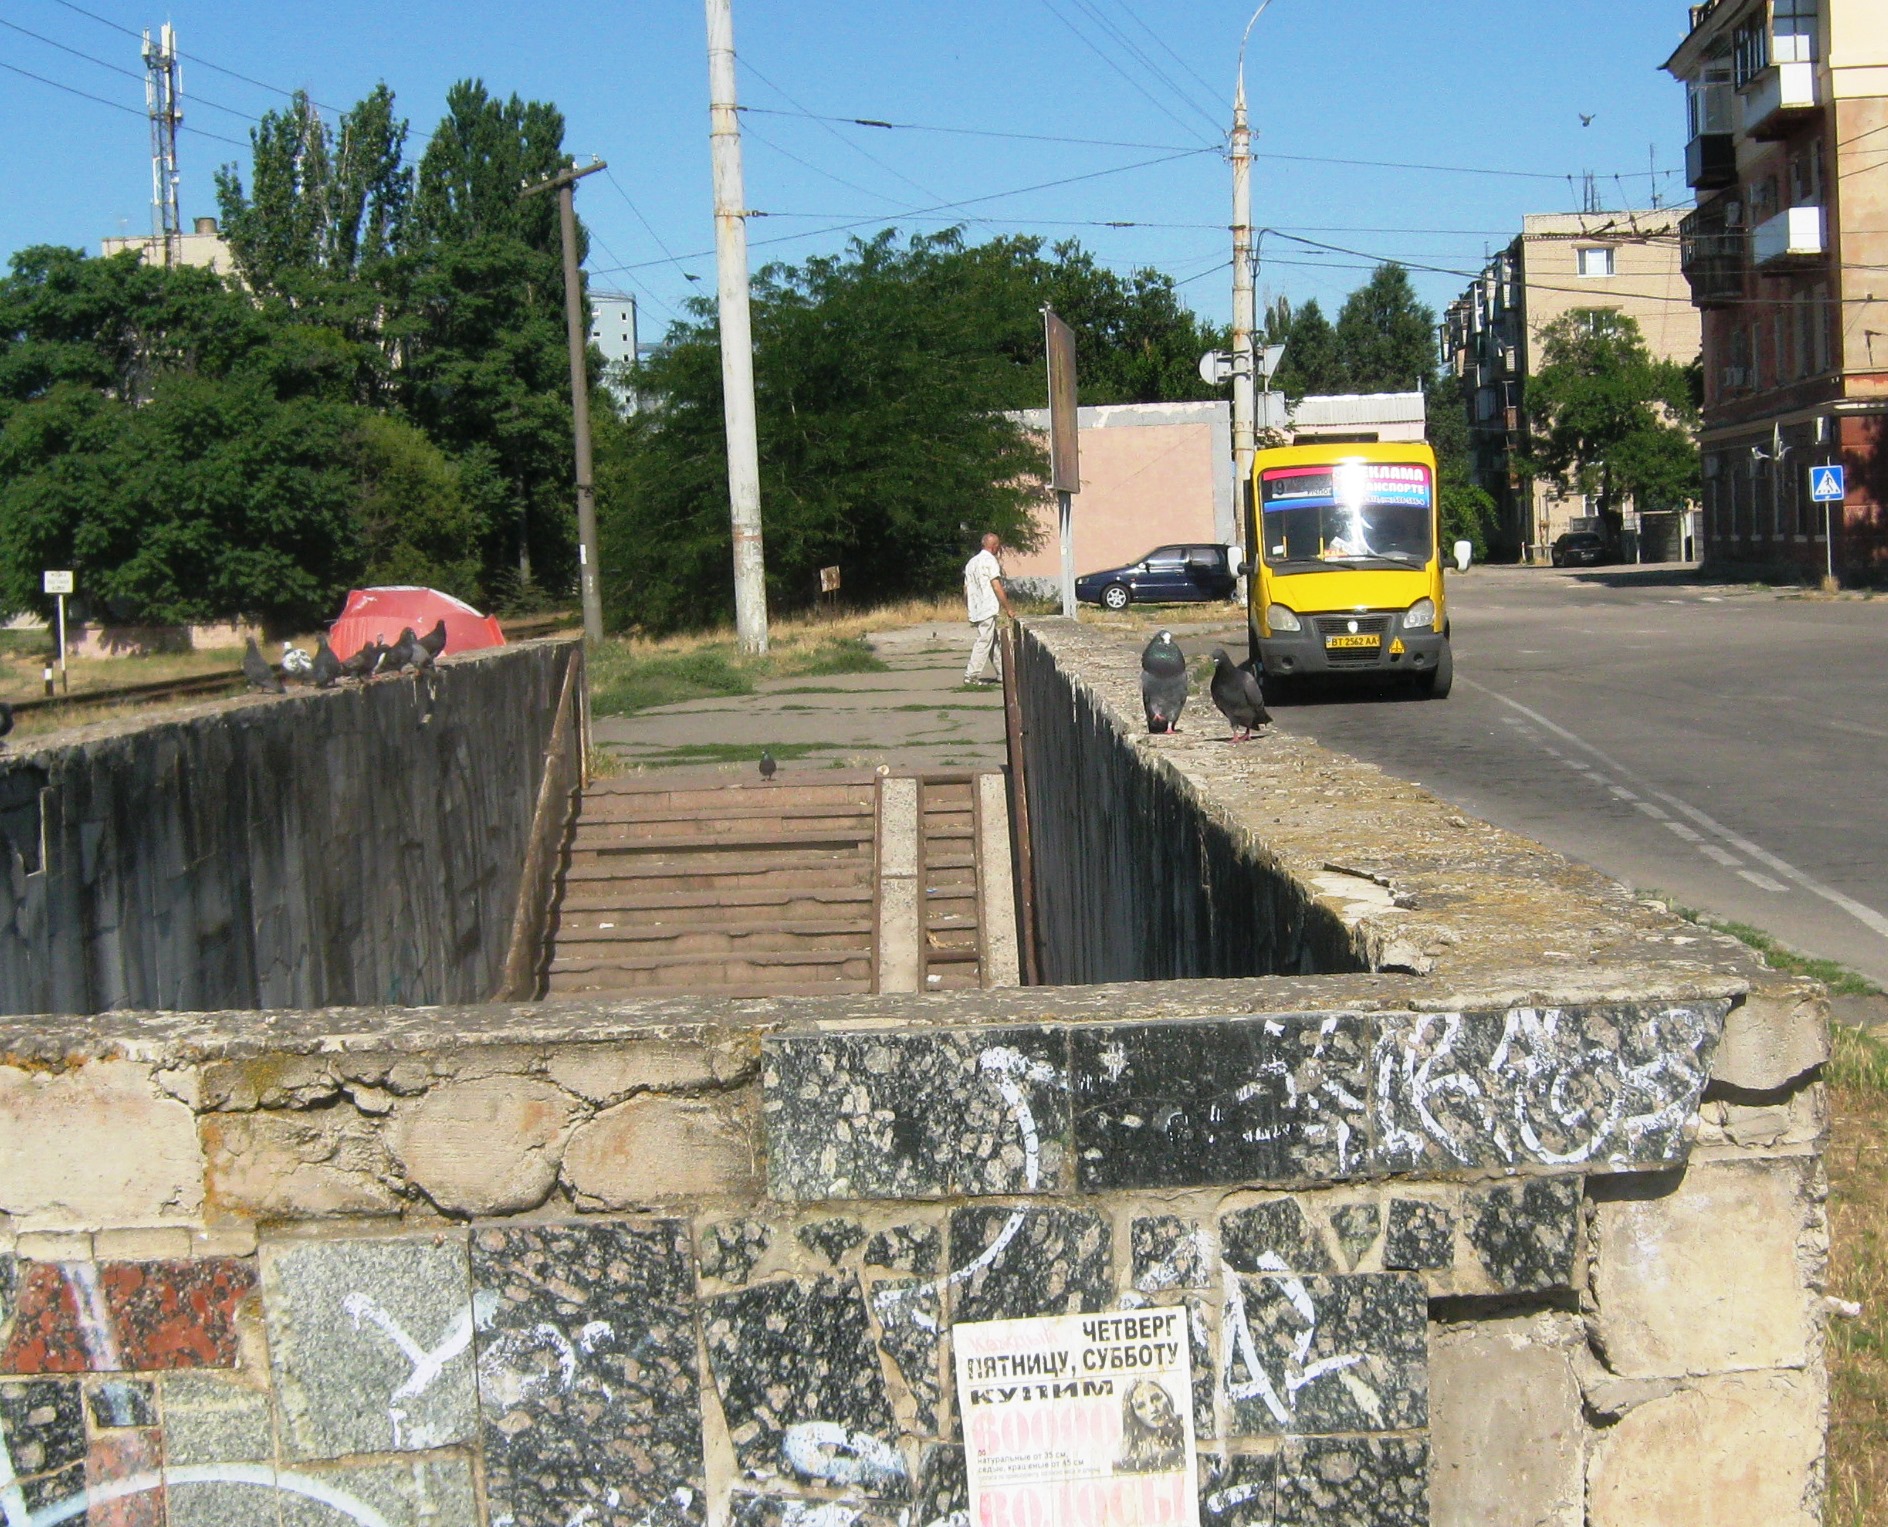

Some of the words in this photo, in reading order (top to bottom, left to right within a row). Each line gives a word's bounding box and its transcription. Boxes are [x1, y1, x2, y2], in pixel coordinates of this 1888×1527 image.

[1356, 465, 1424, 481] ЕКЛАМА
[1275, 480, 1285, 495] 9
[1354, 482, 1425, 495] АНСПОРТЕ
[1331, 637, 1344, 646] BT
[1345, 637, 1364, 646] 2562
[1365, 636, 1378, 645] AA
[1083, 1314, 1177, 1342] ЧЕТВЕРГ
[967, 1350, 1076, 1380] ПЯТНИЦУ,
[1083, 1342, 1178, 1371] СУББОТУ
[971, 1380, 1114, 1405] КУПИМ
